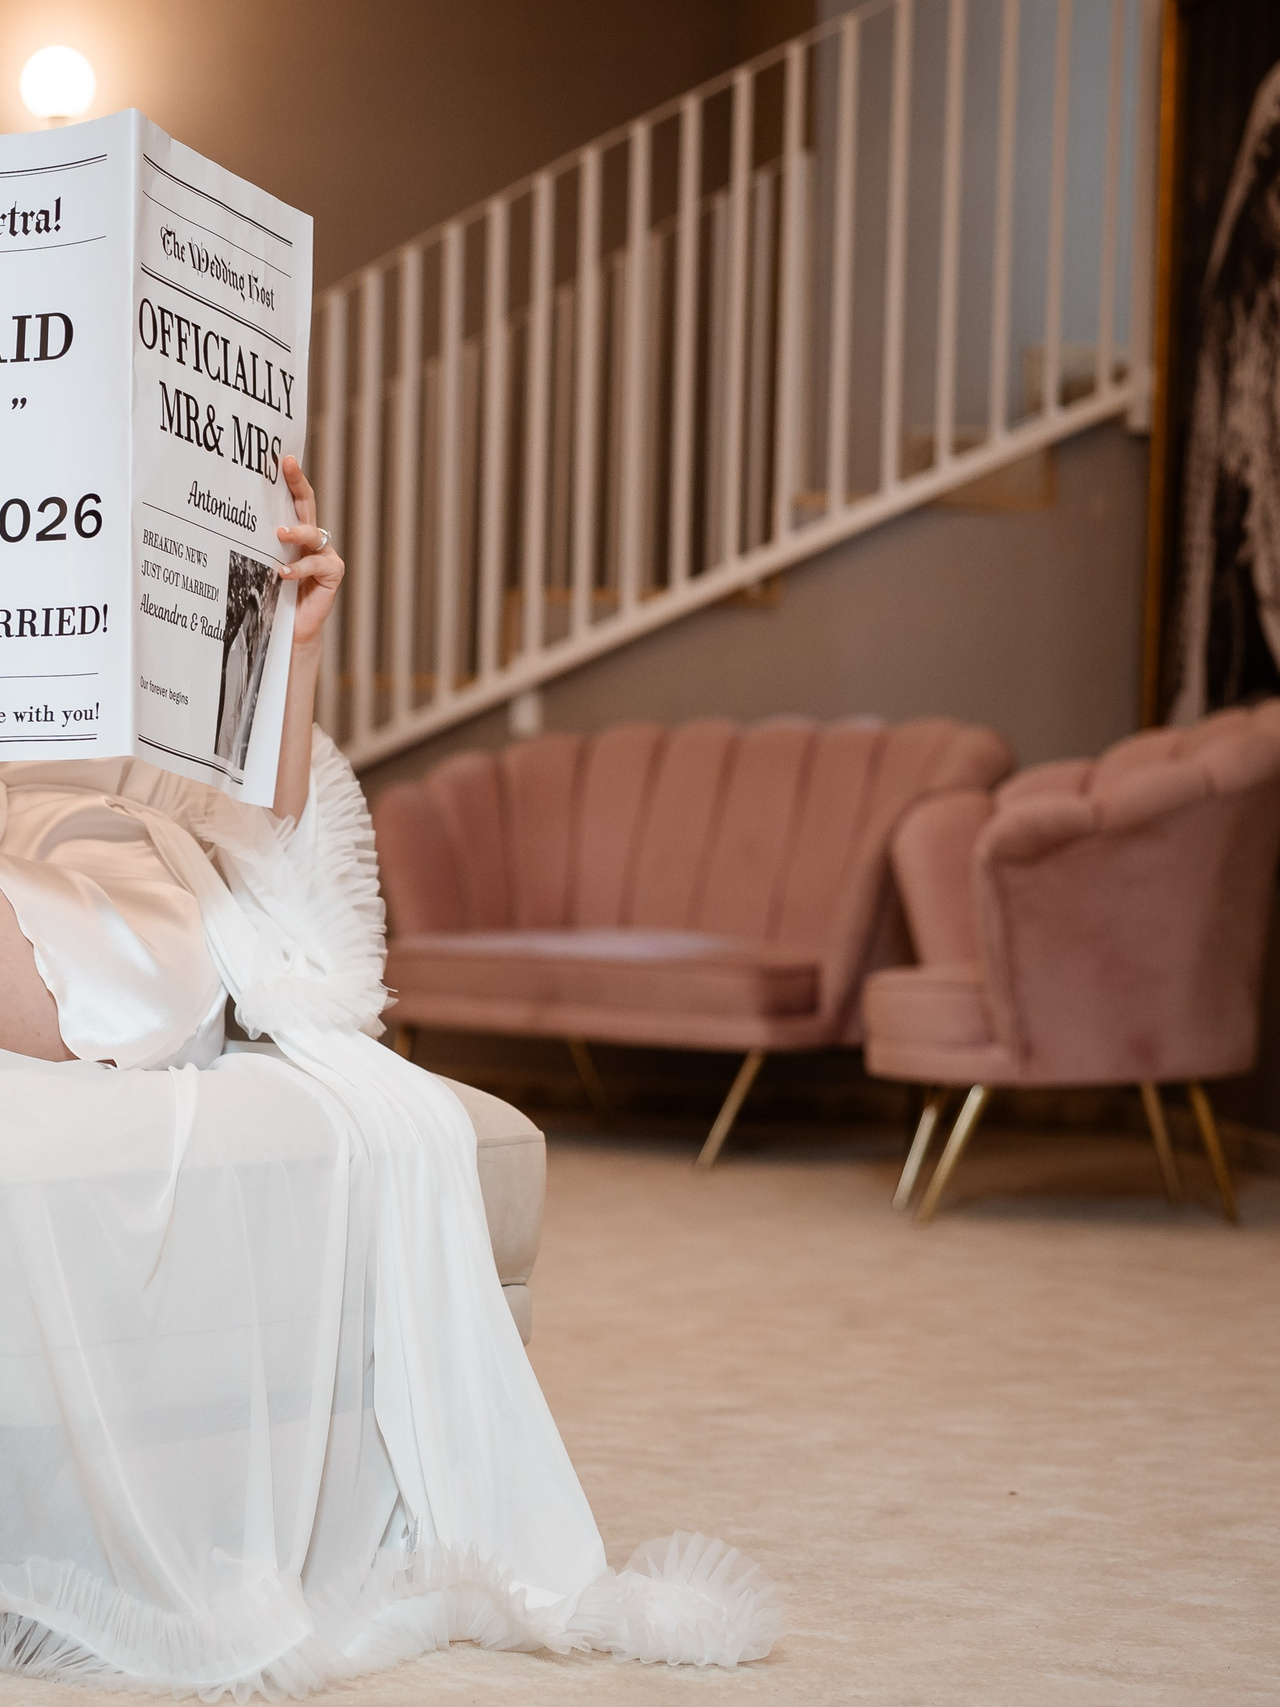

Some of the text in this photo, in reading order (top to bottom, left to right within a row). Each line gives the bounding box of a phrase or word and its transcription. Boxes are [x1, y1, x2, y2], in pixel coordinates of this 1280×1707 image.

[160, 224, 186, 263] The
[187, 238, 246, 302] Wedding
[138, 298, 295, 421] OFFICIALLY
[231, 414, 282, 485] MRS
[187, 480, 257, 532] Antoniadis
[143, 529, 208, 568] BREAKING NEWS
[162, 567, 181, 587] GOT
[181, 574, 220, 602] MARRIED!
[140, 593, 188, 629] Alexandra
[190, 612, 199, 631] &
[12, 705, 55, 723] with
[61, 702, 100, 728] you!
